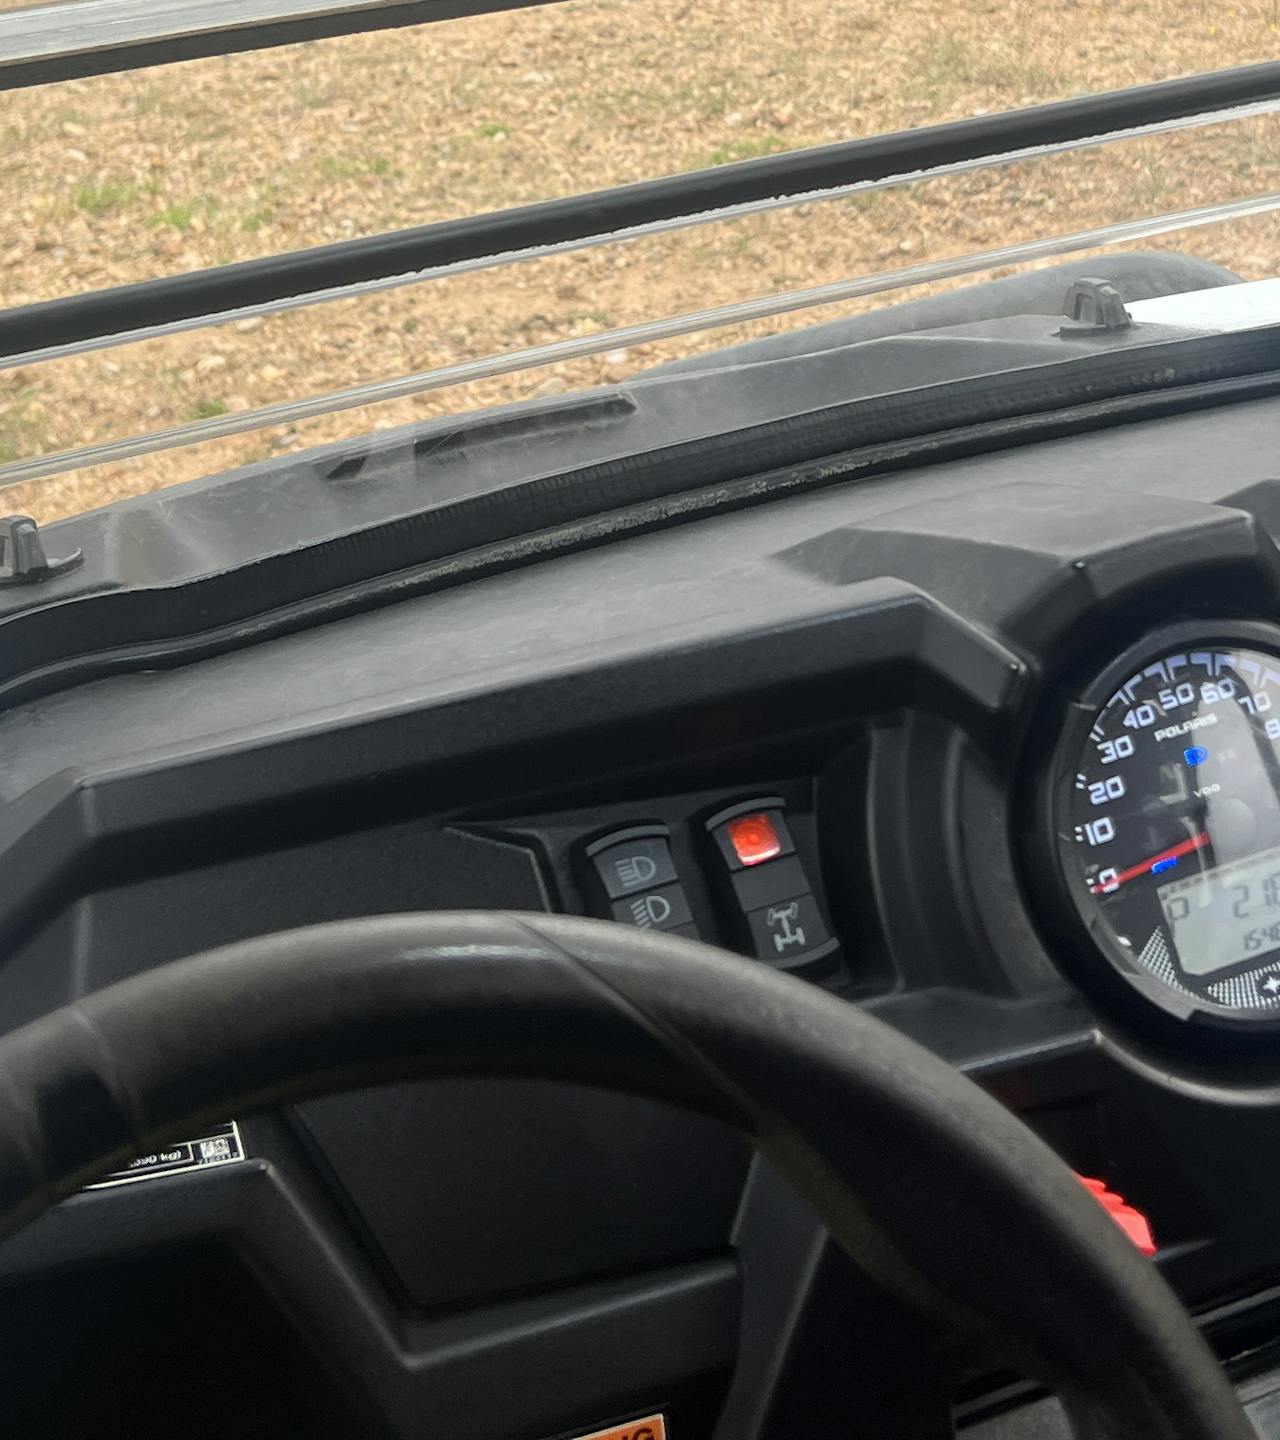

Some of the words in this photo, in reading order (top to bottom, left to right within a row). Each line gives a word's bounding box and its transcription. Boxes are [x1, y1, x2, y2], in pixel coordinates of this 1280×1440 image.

[1158, 682, 1195, 710] 50
[1200, 678, 1235, 705] 60
[1238, 691, 1272, 714] 70
[1123, 704, 1155, 730] 40
[1154, 712, 1218, 742] POLARIS
[1097, 735, 1135, 764] 30
[1088, 775, 1126, 805] 20
[1193, 783, 1221, 798] VDO
[1084, 817, 1115, 845] 10
[1099, 867, 1120, 893] 0
